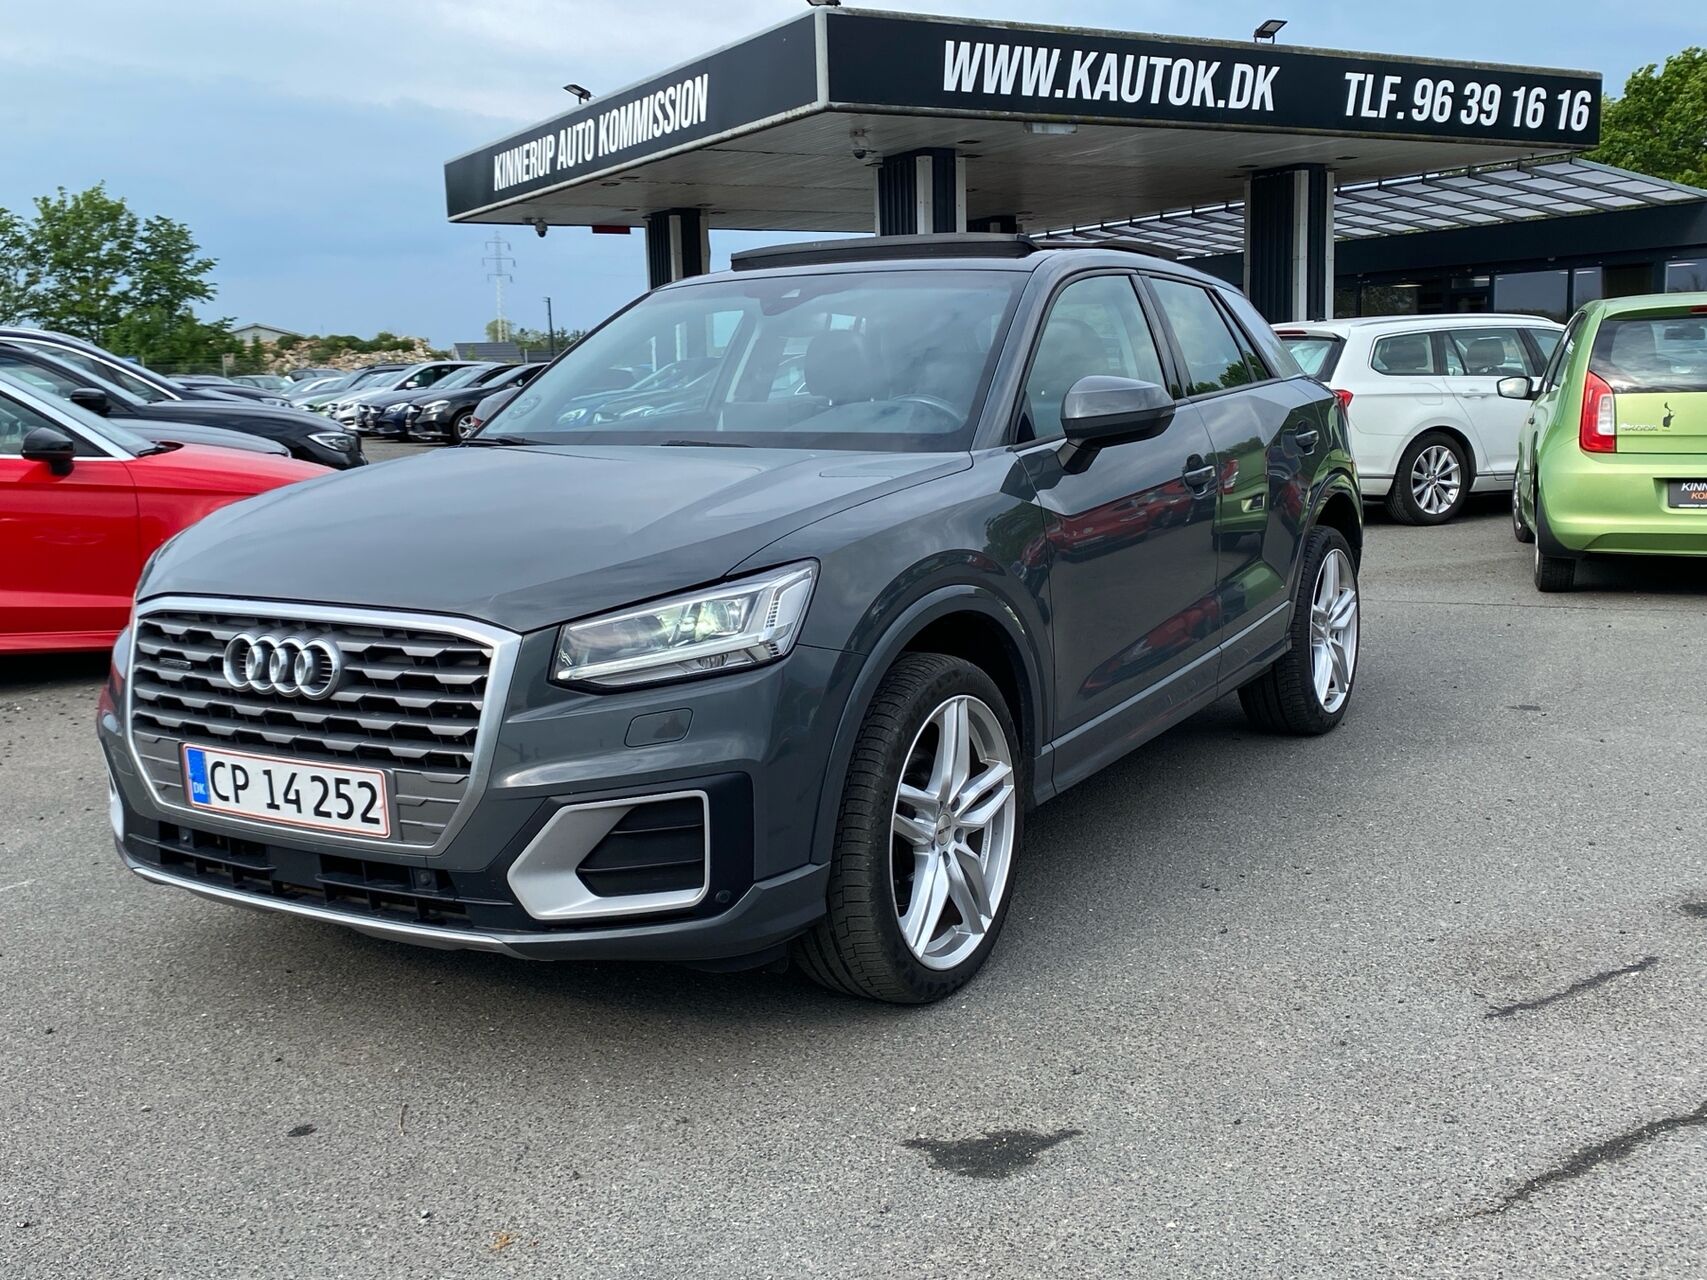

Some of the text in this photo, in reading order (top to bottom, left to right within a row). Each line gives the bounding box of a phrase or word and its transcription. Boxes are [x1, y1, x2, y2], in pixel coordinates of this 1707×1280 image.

[943, 40, 1280, 112] WWW.KAUTOK.DK
[1345, 72, 1592, 132] TLF. 96 39 16 16
[494, 73, 709, 191] KINNERUP AUTO KOMMISSION
[1691, 492, 1707, 500] KO
[193, 782, 206, 794] DK
[210, 760, 250, 803] CP
